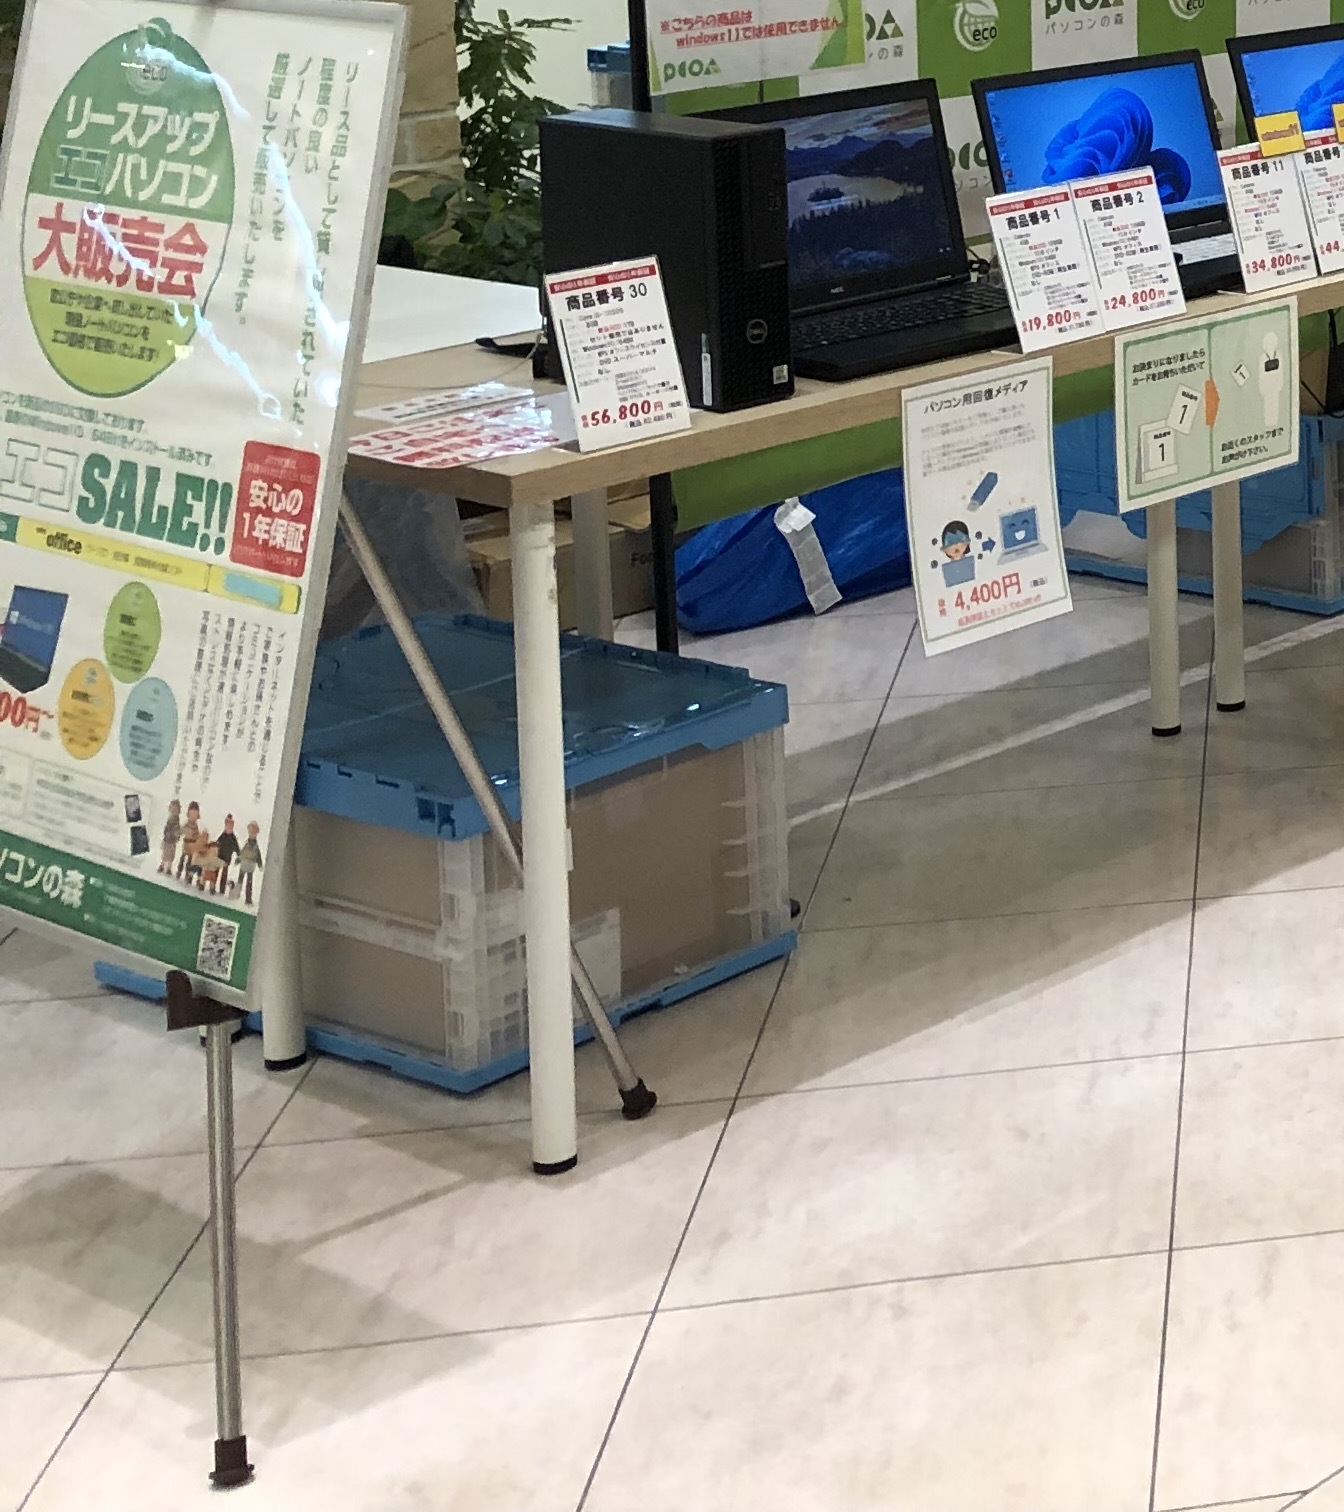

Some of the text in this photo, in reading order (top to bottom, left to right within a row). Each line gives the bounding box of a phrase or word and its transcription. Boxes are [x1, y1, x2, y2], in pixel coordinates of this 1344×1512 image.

[972, 24, 999, 42] eco
[1044, 12, 1125, 36] パソコンの森
[65, 93, 221, 158] リースアップ
[1303, 146, 1342, 165] 商品番号
[52, 144, 220, 211] エコパソコン
[1231, 159, 1285, 181] 商品番号 11
[1089, 190, 1145, 213] 商品番号 2
[1005, 207, 1060, 231] 商品番号 1
[31, 201, 210, 301] 大販売会
[1251, 252, 1301, 274] 34,800円
[565, 282, 648, 313] 商品番号 30
[1110, 287, 1166, 310] 24,800円
[1027, 309, 1082, 333] 19,800円
[923, 379, 1029, 414] パソコン用回復メディア
[590, 398, 665, 428] 56,800円
[1158, 442, 1165, 462] 1
[76, 452, 234, 556] SALE!!
[248, 477, 305, 516] 安心の
[241, 513, 308, 555] 1年保証
[954, 571, 1022, 612] 4,400円
